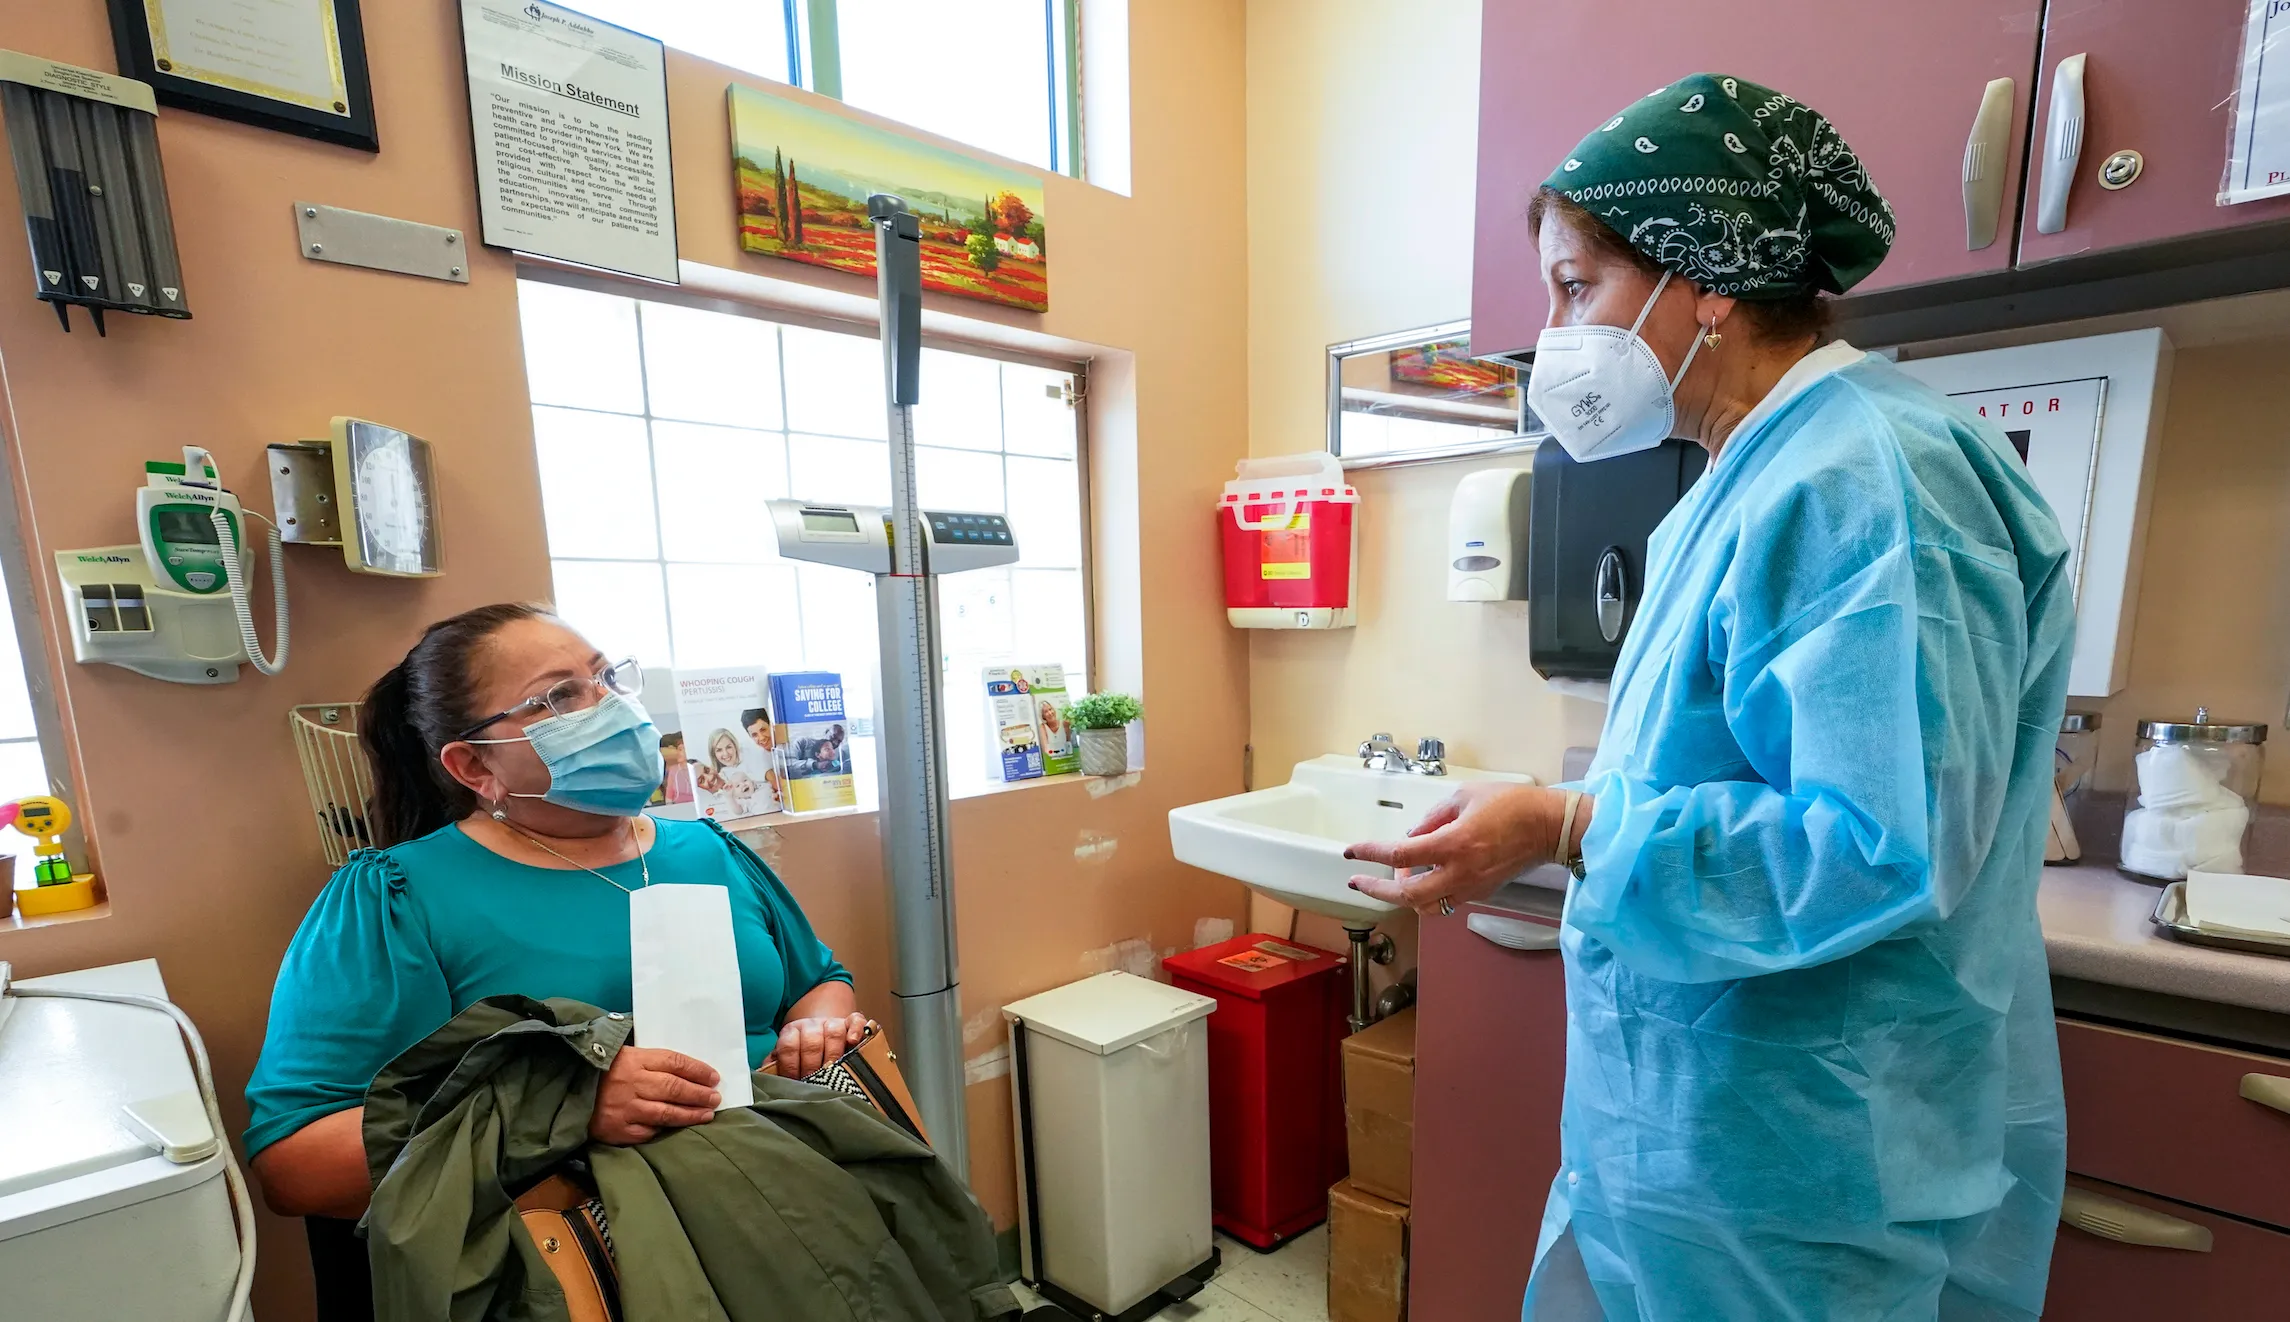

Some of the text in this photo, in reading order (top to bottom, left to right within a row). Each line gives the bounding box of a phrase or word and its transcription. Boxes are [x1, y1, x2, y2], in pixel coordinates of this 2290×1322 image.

[541, 12, 561, 24] Joseph
[44, 71, 88, 86] DIAGNOSTIC
[90, 82, 112, 91] STYLE
[501, 63, 640, 116] Mission Statement
[491, 103, 653, 153] preventive and comprehensive primary
[492, 111, 517, 124] health
[520, 120, 537, 130] care
[540, 126, 573, 139] provider
[585, 136, 602, 147] New
[628, 148, 640, 157] We
[518, 102, 550, 115] mission
[589, 121, 599, 129] be
[607, 126, 619, 135] the
[626, 131, 652, 145] leading
[493, 122, 536, 138] committed
[539, 133, 548, 141] to
[551, 138, 588, 153] providing
[591, 148, 622, 161] services
[625, 156, 639, 166] that
[562, 148, 580, 159] high
[495, 140, 510, 149] and
[588, 163, 620, 177] Services
[646, 178, 655, 186] be
[496, 150, 531, 164] provided
[539, 161, 556, 170] with
[564, 167, 592, 179] respect
[599, 175, 607, 183] to
[614, 179, 626, 187] the
[497, 167, 511, 176] the
[517, 173, 568, 190] communities
[628, 198, 657, 212] Through
[571, 178, 585, 186] and
[587, 182, 623, 195] economic
[625, 191, 647, 201] needs
[500, 195, 513, 203] the
[520, 200, 570, 216] expectations
[611, 221, 639, 232] patients
[566, 202, 579, 210] will
[581, 206, 617, 219] anticipate
[633, 218, 658, 228] exceed
[598, 201, 612, 209] and
[619, 207, 658, 221] community
[78, 555, 130, 564] WelchAllyn
[679, 675, 755, 688] WHOOPING COUGH
[681, 686, 725, 697] (PERTUSSIS)
[794, 687, 841, 701] SAVING FOR
[808, 700, 843, 713] COLLEGE
